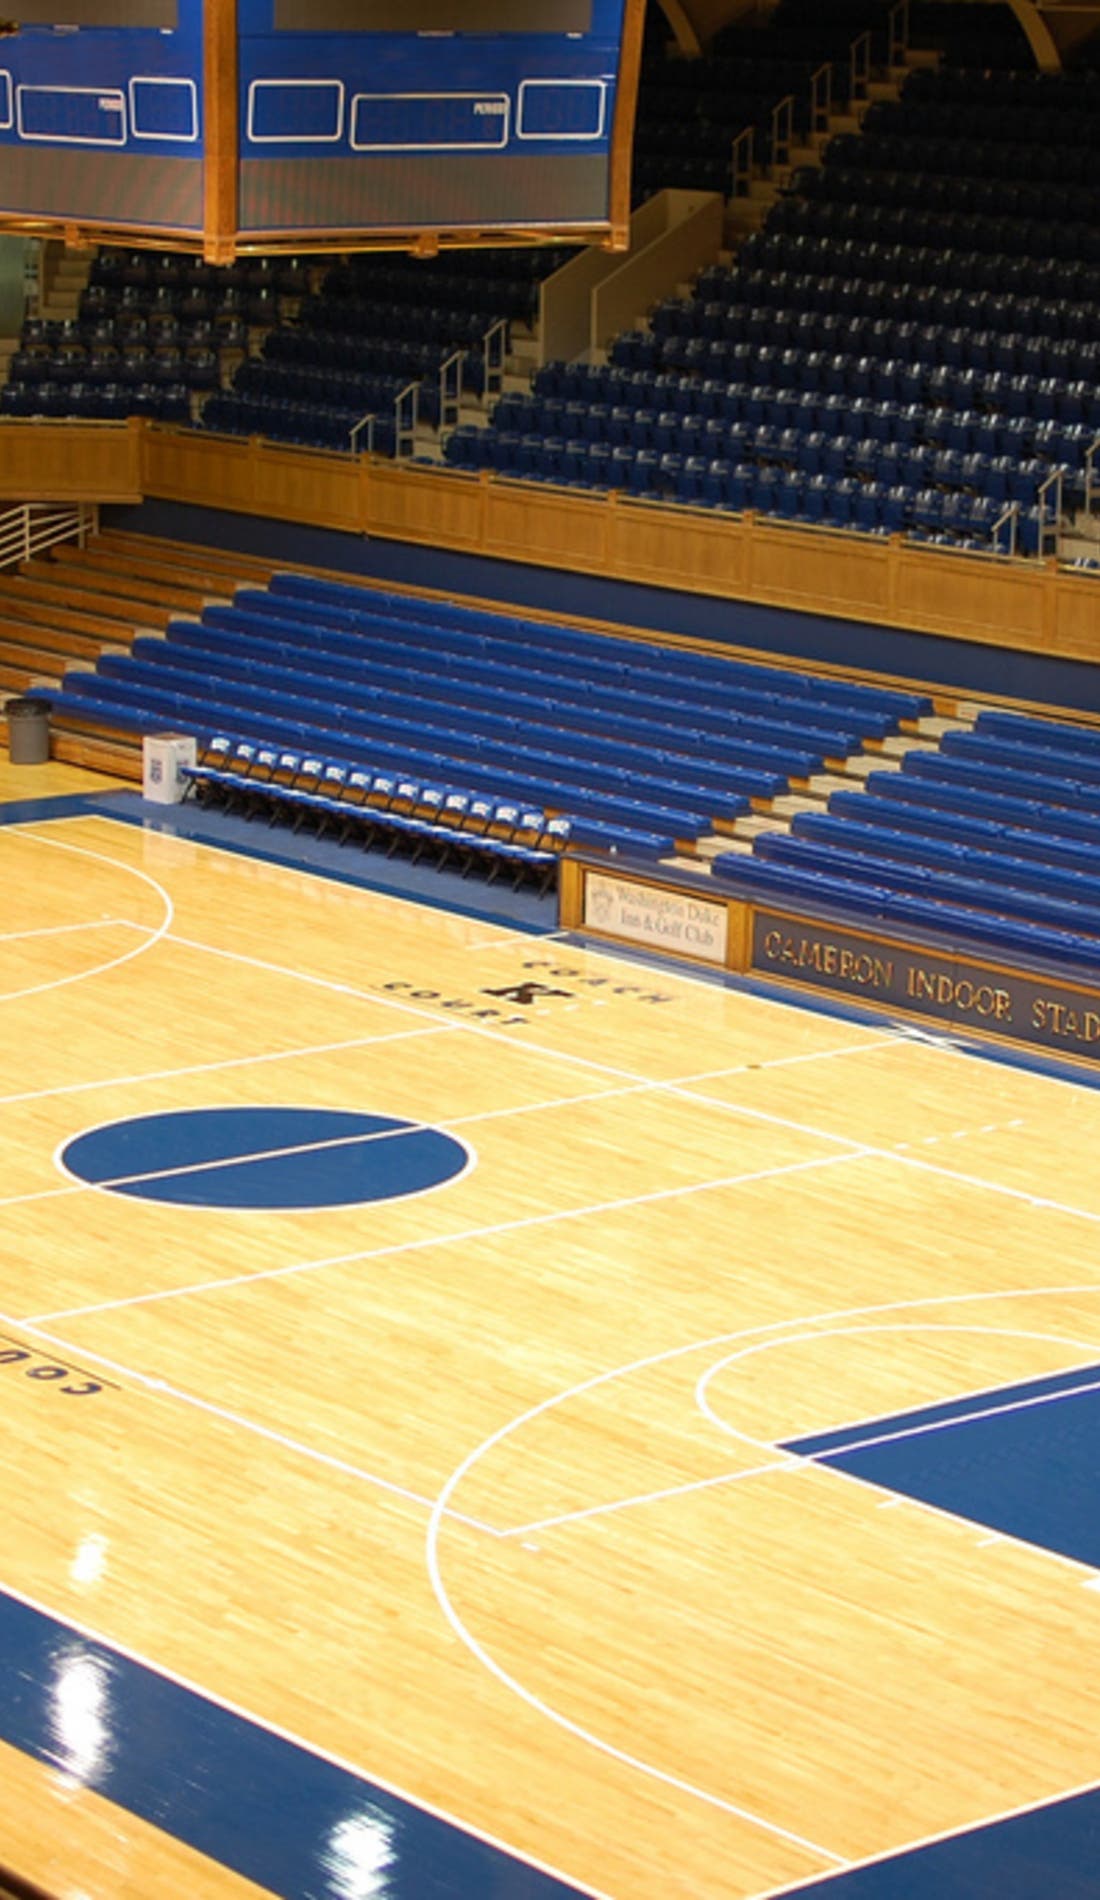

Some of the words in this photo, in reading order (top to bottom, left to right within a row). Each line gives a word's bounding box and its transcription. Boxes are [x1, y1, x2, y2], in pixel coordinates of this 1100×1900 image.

[617, 884, 684, 917] Washington
[687, 902, 719, 927] Duke
[621, 907, 641, 927] Inn
[654, 916, 682, 939] Golf
[685, 923, 714, 946] Club
[764, 930, 894, 988] CAMERON
[907, 967, 1013, 1022] INDOOR
[382, 980, 530, 1026] COURT
